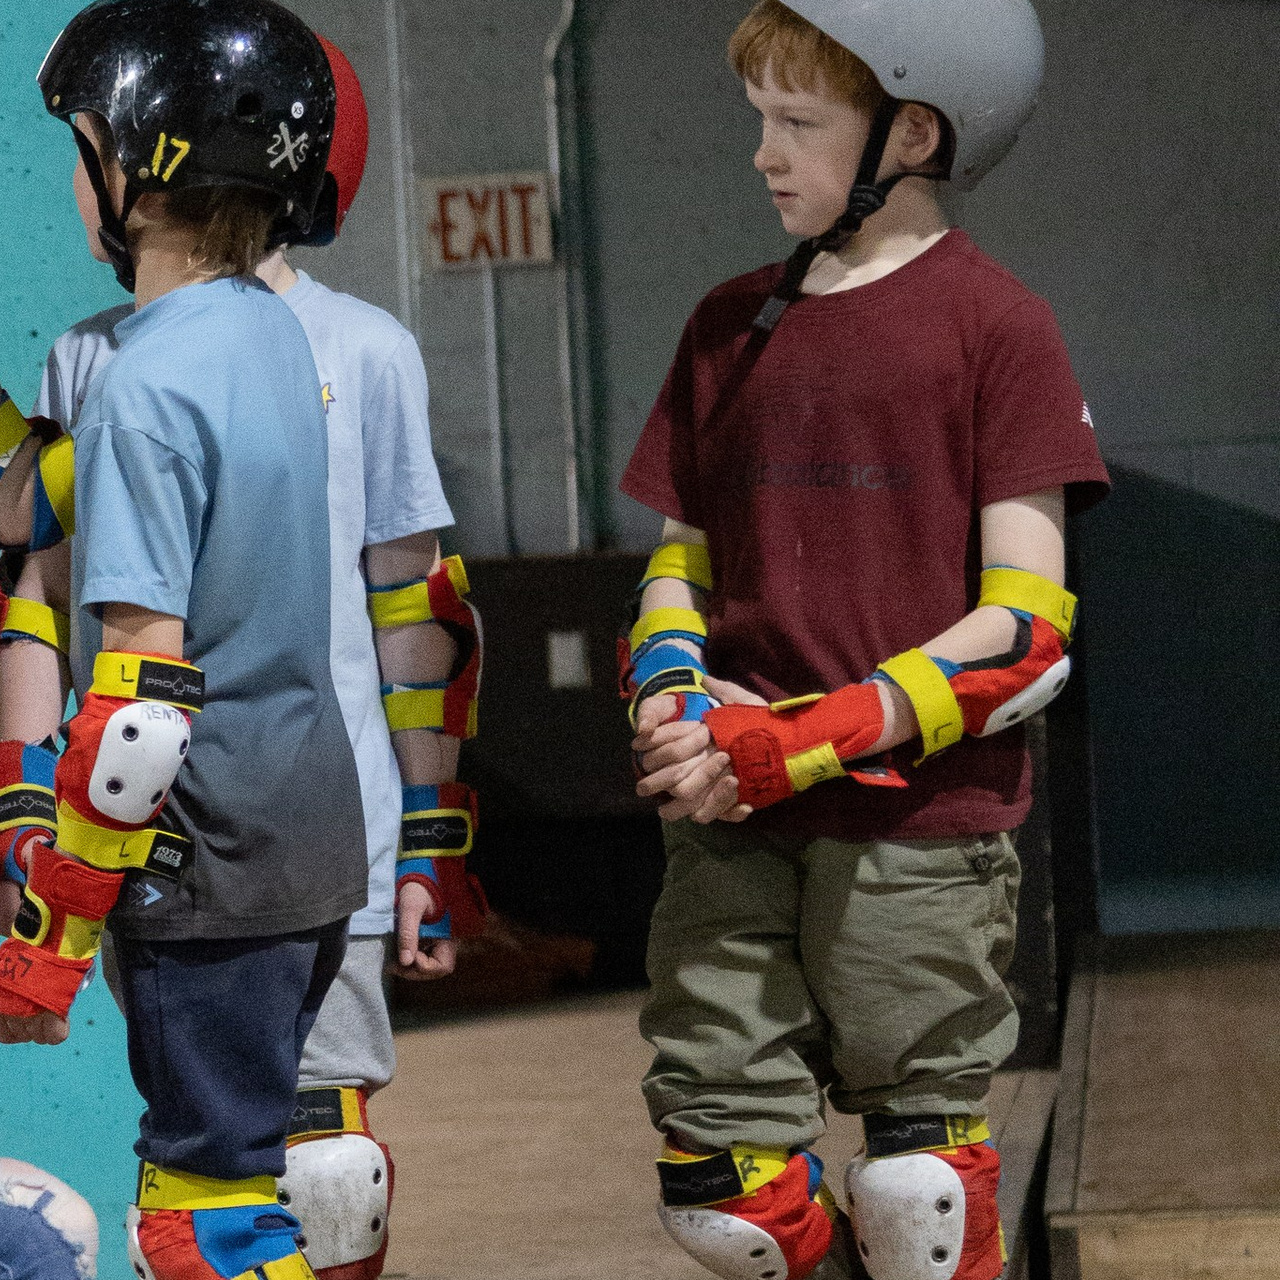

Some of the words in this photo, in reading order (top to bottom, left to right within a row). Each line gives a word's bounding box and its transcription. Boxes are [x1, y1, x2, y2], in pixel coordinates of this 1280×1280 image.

[152, 132, 191, 182] 17
[437, 184, 536, 263] EXIT
[121, 663, 135, 683] L
